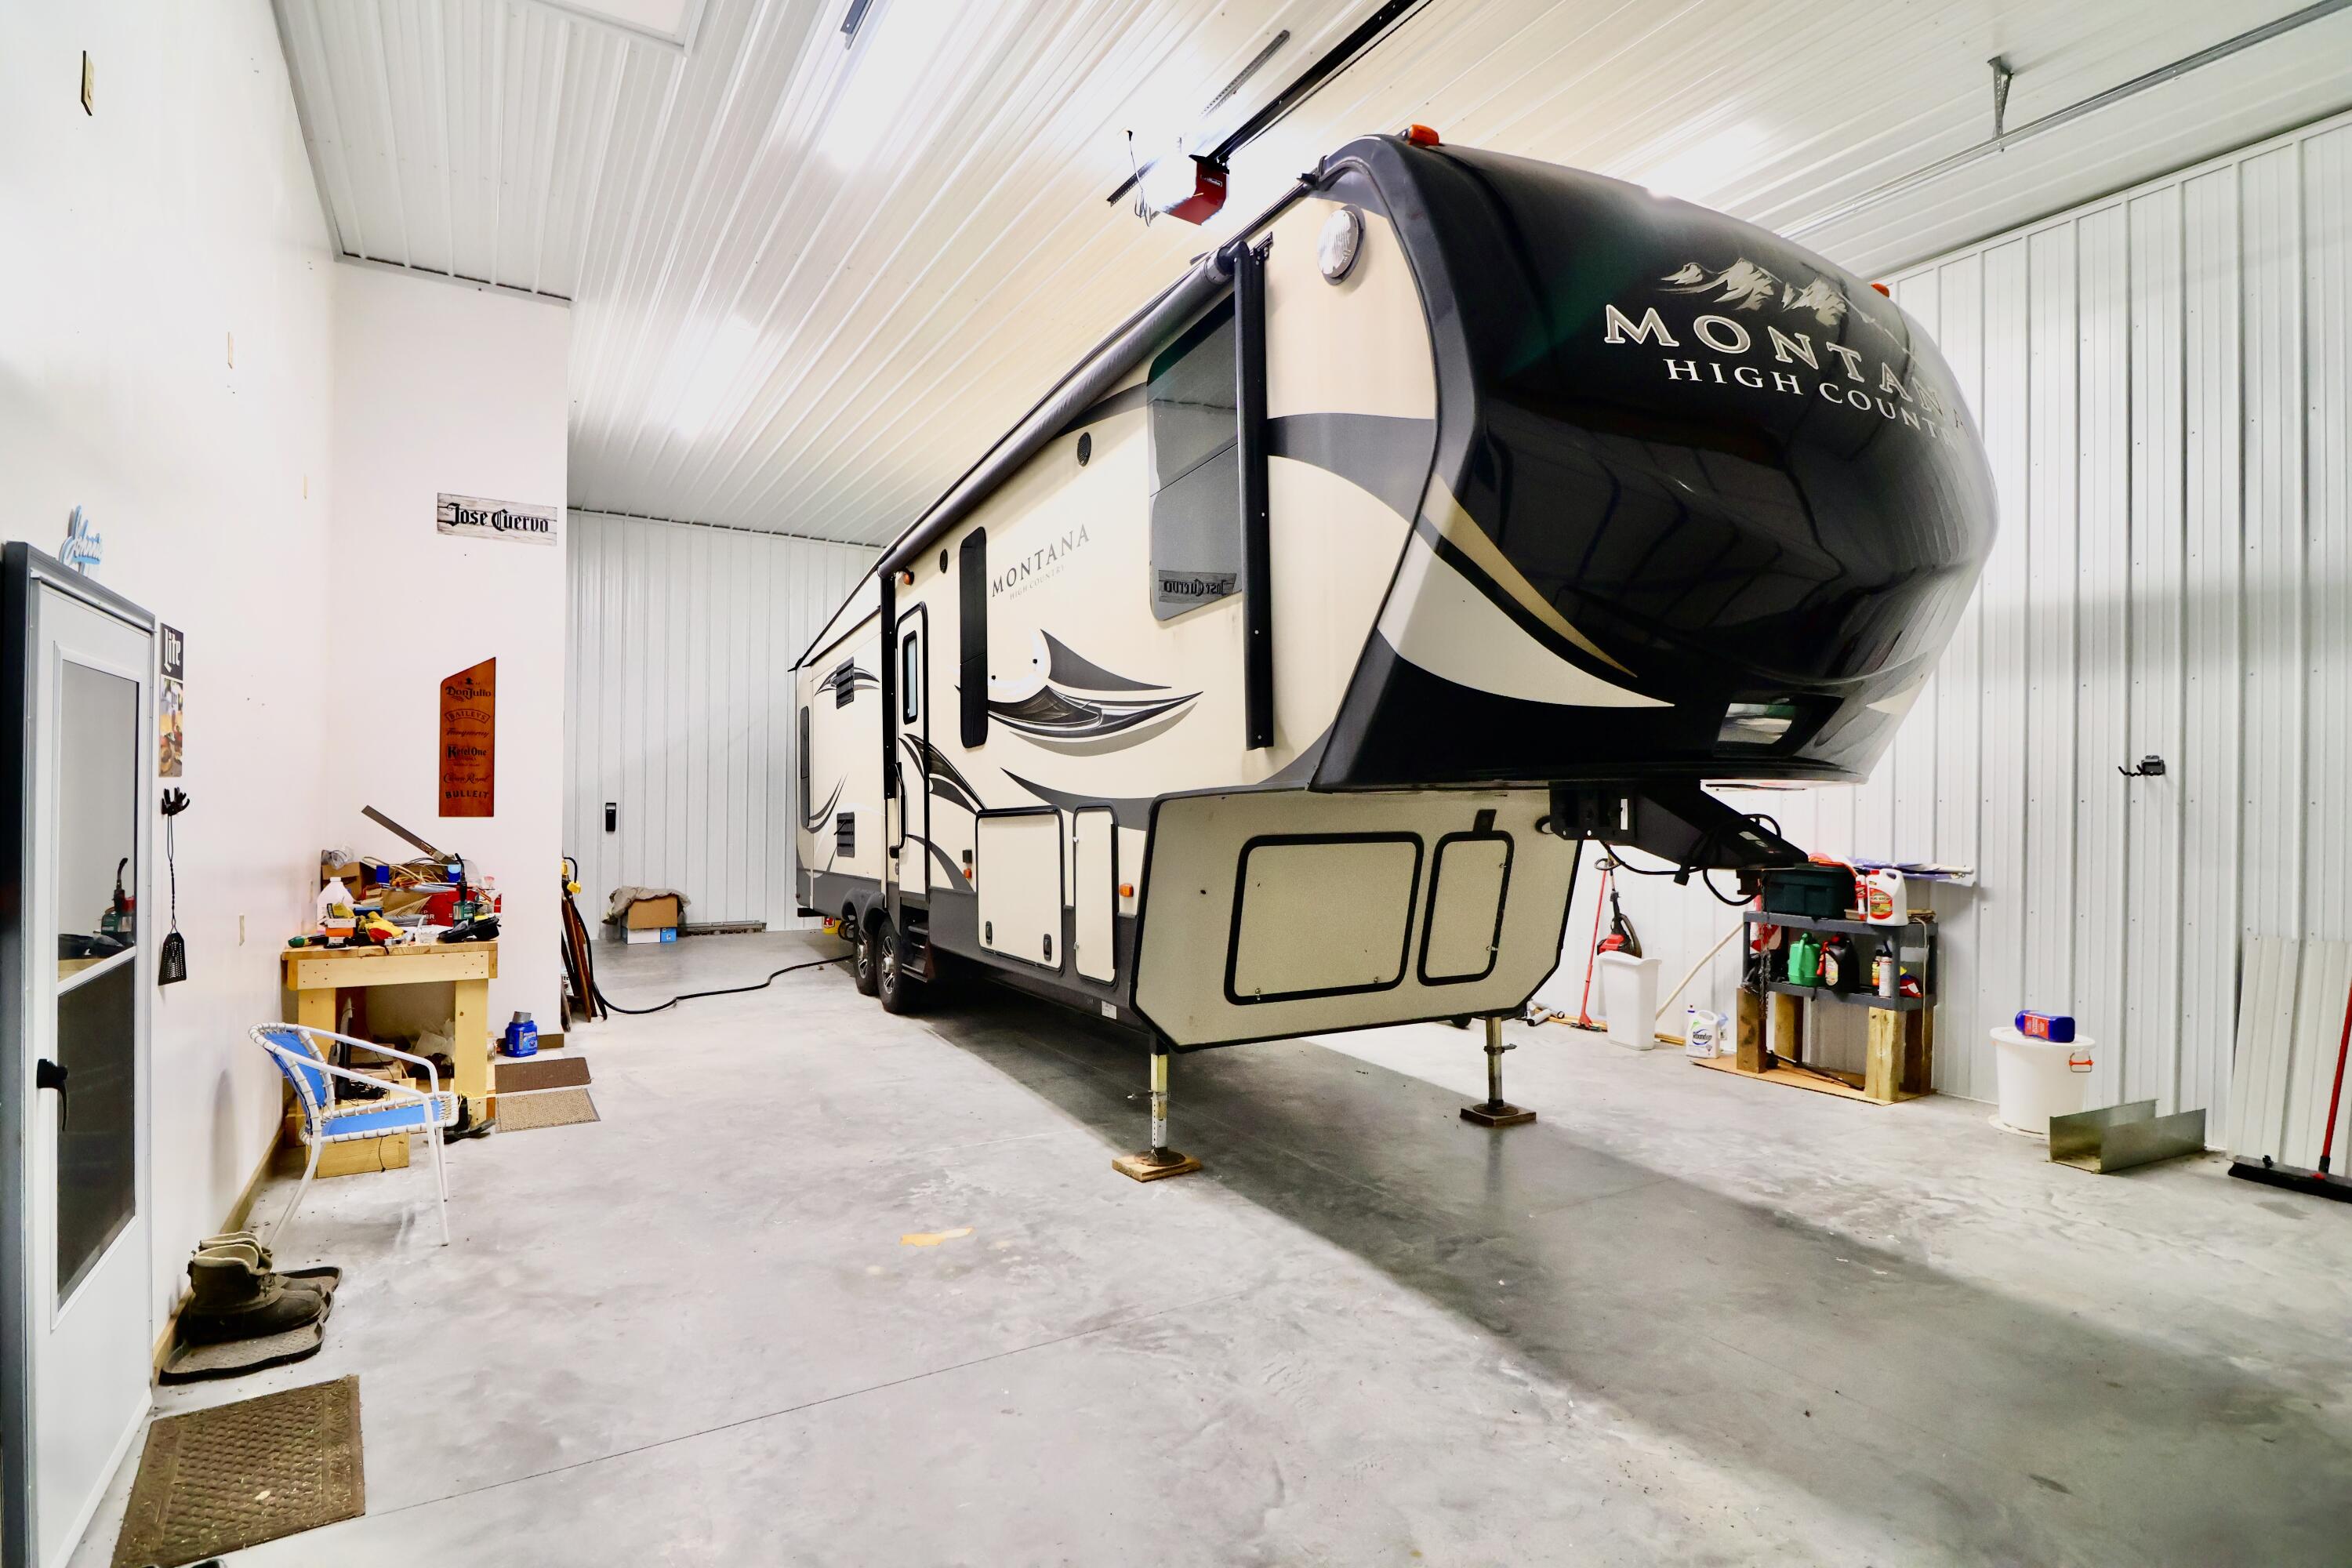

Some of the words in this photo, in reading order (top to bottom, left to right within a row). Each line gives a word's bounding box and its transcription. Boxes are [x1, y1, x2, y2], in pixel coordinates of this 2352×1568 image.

[1663, 358, 1803, 395] HIGH
[1819, 383, 1956, 449] COUNTR
[446, 503, 488, 526] Jose
[492, 509, 549, 532] Cuervo
[992, 524, 1090, 597] MONTANA
[1010, 584, 1028, 601] HIGH
[1029, 564, 1066, 589] COUNTRY
[164, 628, 181, 673] Lite
[448, 710, 486, 720] BAILEYS
[445, 789, 490, 799] BULLEIT
